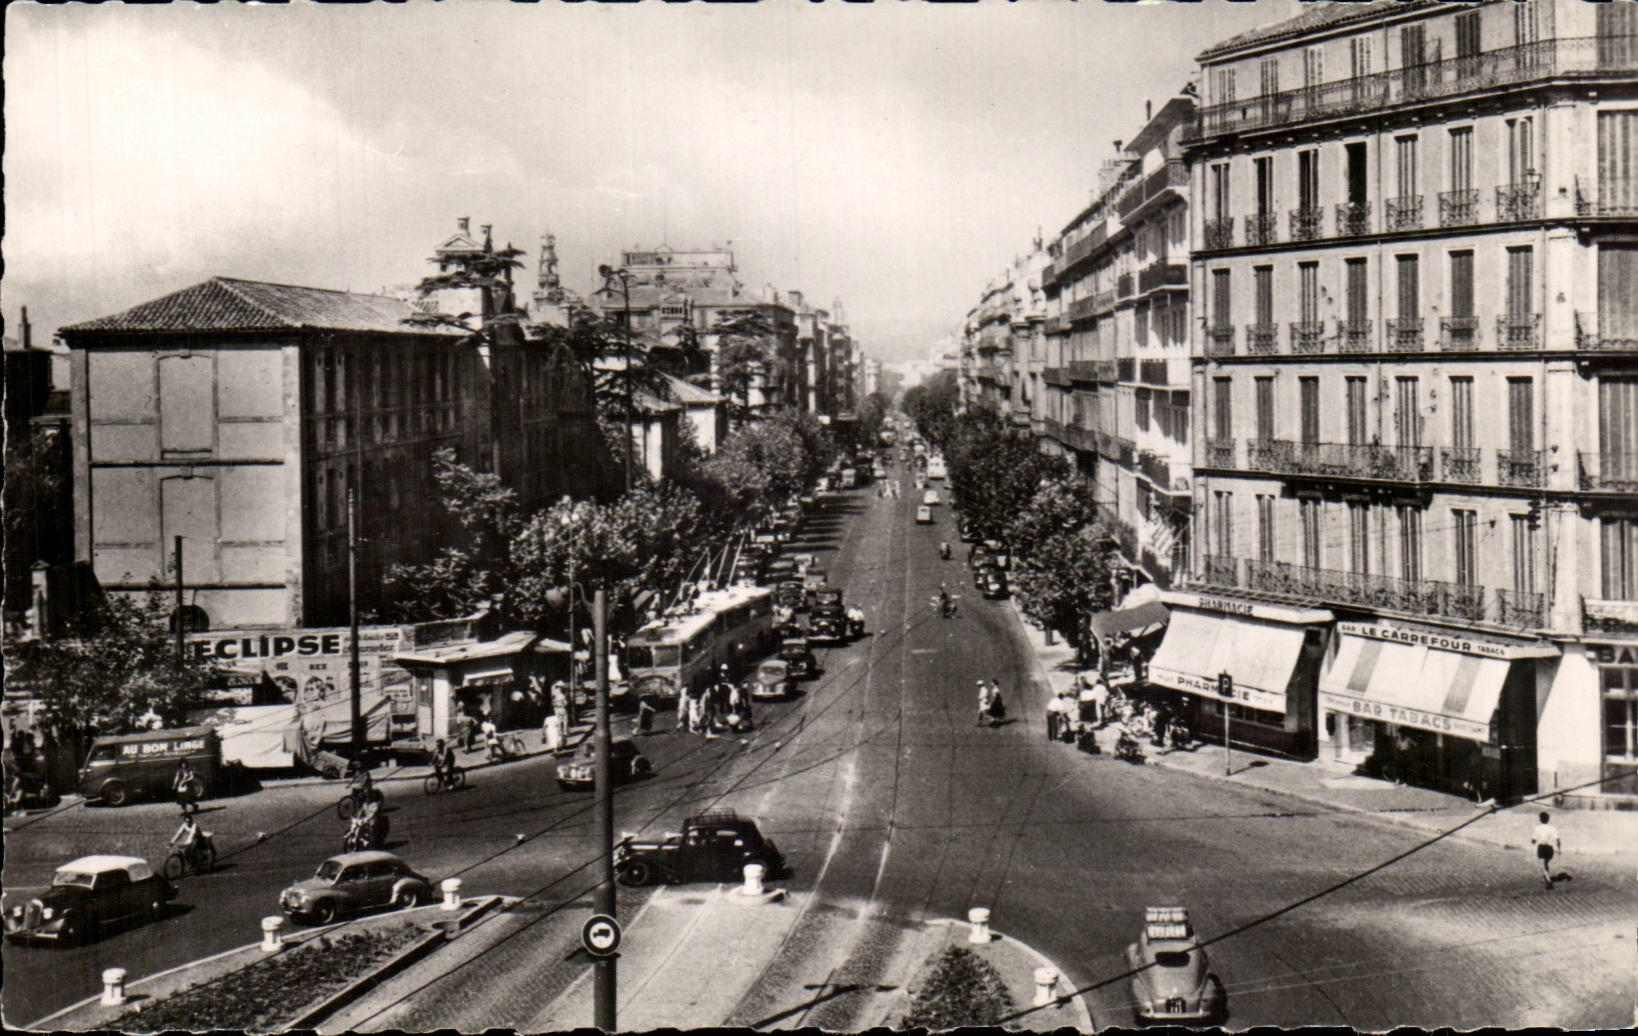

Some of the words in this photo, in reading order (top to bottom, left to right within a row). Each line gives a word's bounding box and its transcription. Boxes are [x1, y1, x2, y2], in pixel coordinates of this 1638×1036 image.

[1199, 598, 1254, 616] PHARMACIE
[194, 634, 340, 660] ECLIPSE
[1362, 626, 1377, 636] LE
[1381, 629, 1472, 652] CARREFOUR
[1477, 644, 1506, 656] TABACS
[1177, 676, 1250, 701] PHARMCIE
[1222, 677, 1230, 692] P
[1352, 700, 1382, 717] BAR
[1389, 708, 1451, 731] TABACS
[122, 744, 139, 756] AU
[142, 742, 169, 754] BON
[173, 739, 206, 752] LINGE
